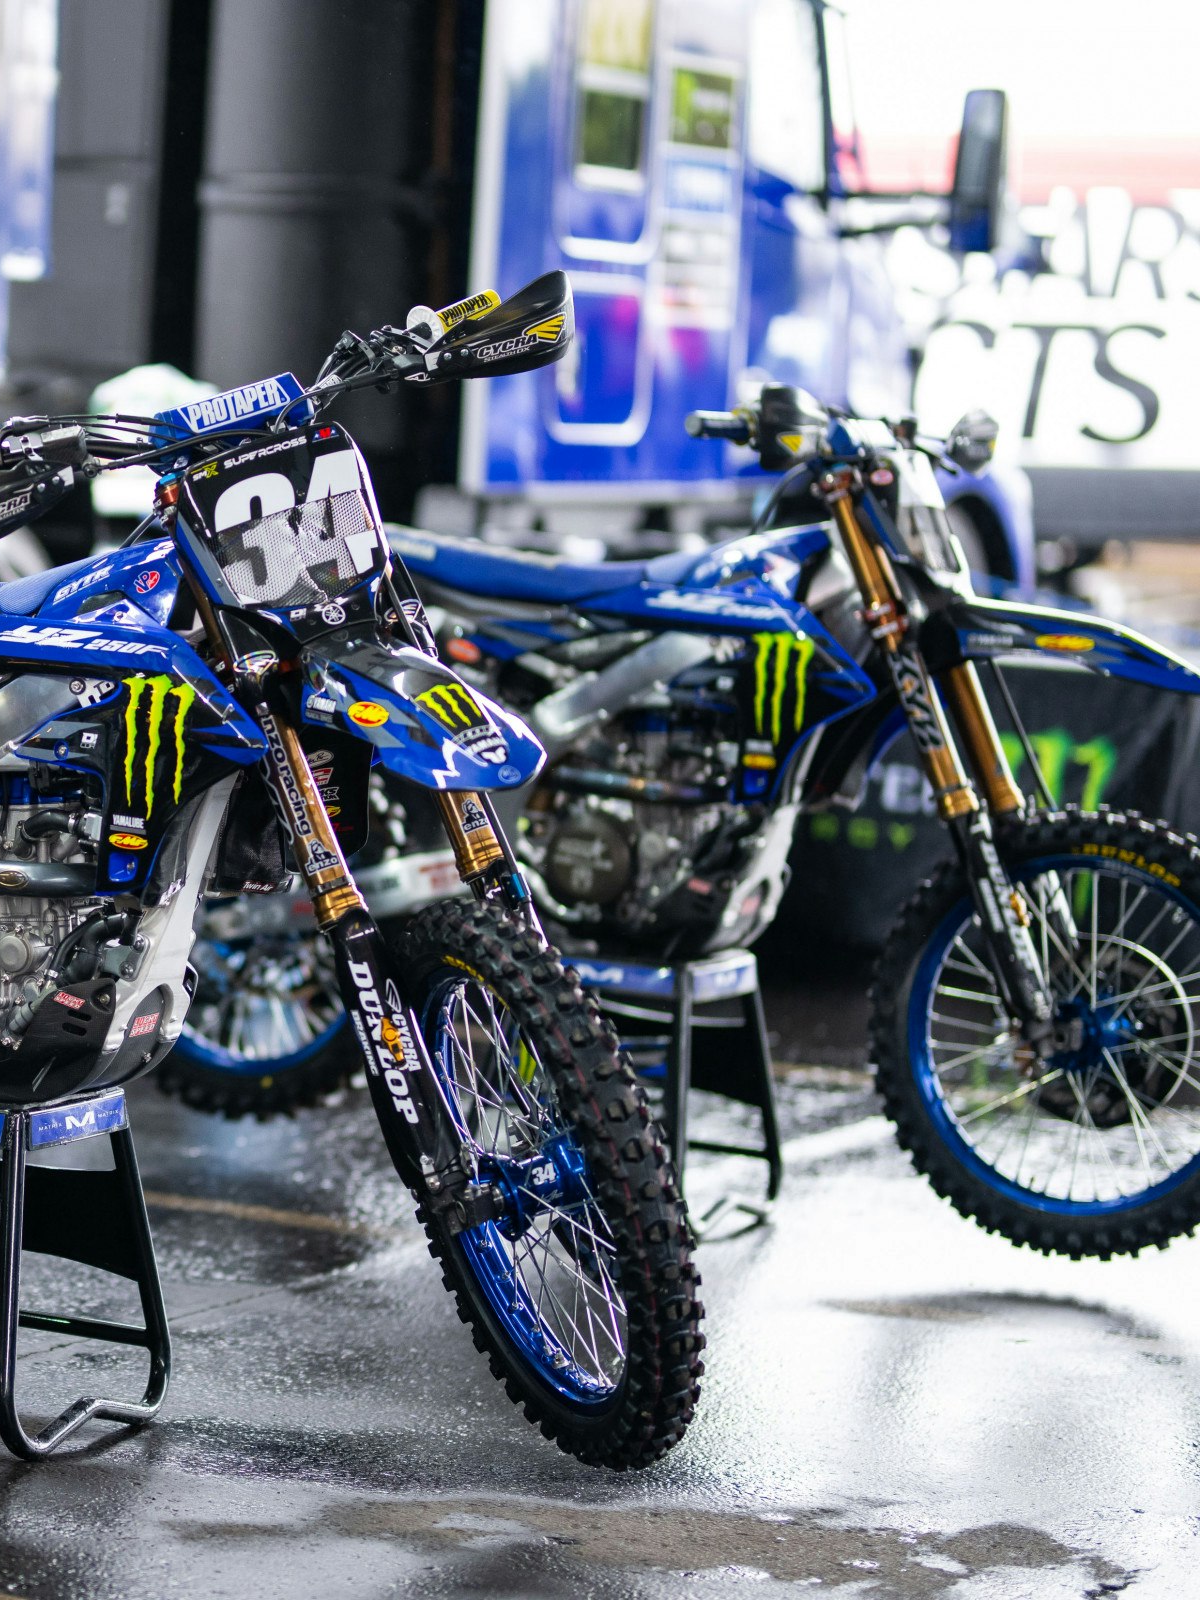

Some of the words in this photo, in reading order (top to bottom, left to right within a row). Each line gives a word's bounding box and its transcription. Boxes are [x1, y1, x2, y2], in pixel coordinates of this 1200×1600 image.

[443, 294, 488, 325] PROTAPER
[477, 333, 538, 358] CYCRA
[186, 379, 280, 428] PROTAPER
[224, 436, 307, 469] SUPERCROSS
[53, 564, 114, 602] GYTR
[133, 571, 151, 591] VP
[83, 639, 170, 659] 250F
[279, 765, 312, 837] racing
[112, 814, 144, 829] YAMALUBE
[109, 833, 149, 850] FMF
[307, 857, 338, 874] enzo
[243, 881, 262, 891] Twin
[261, 882, 274, 892] Air
[348, 960, 419, 1124] DUNLOP
[350, 1009, 380, 1077] BRAKING
[38, 1122, 63, 1131] MATRIX
[531, 1162, 557, 1186] 34
